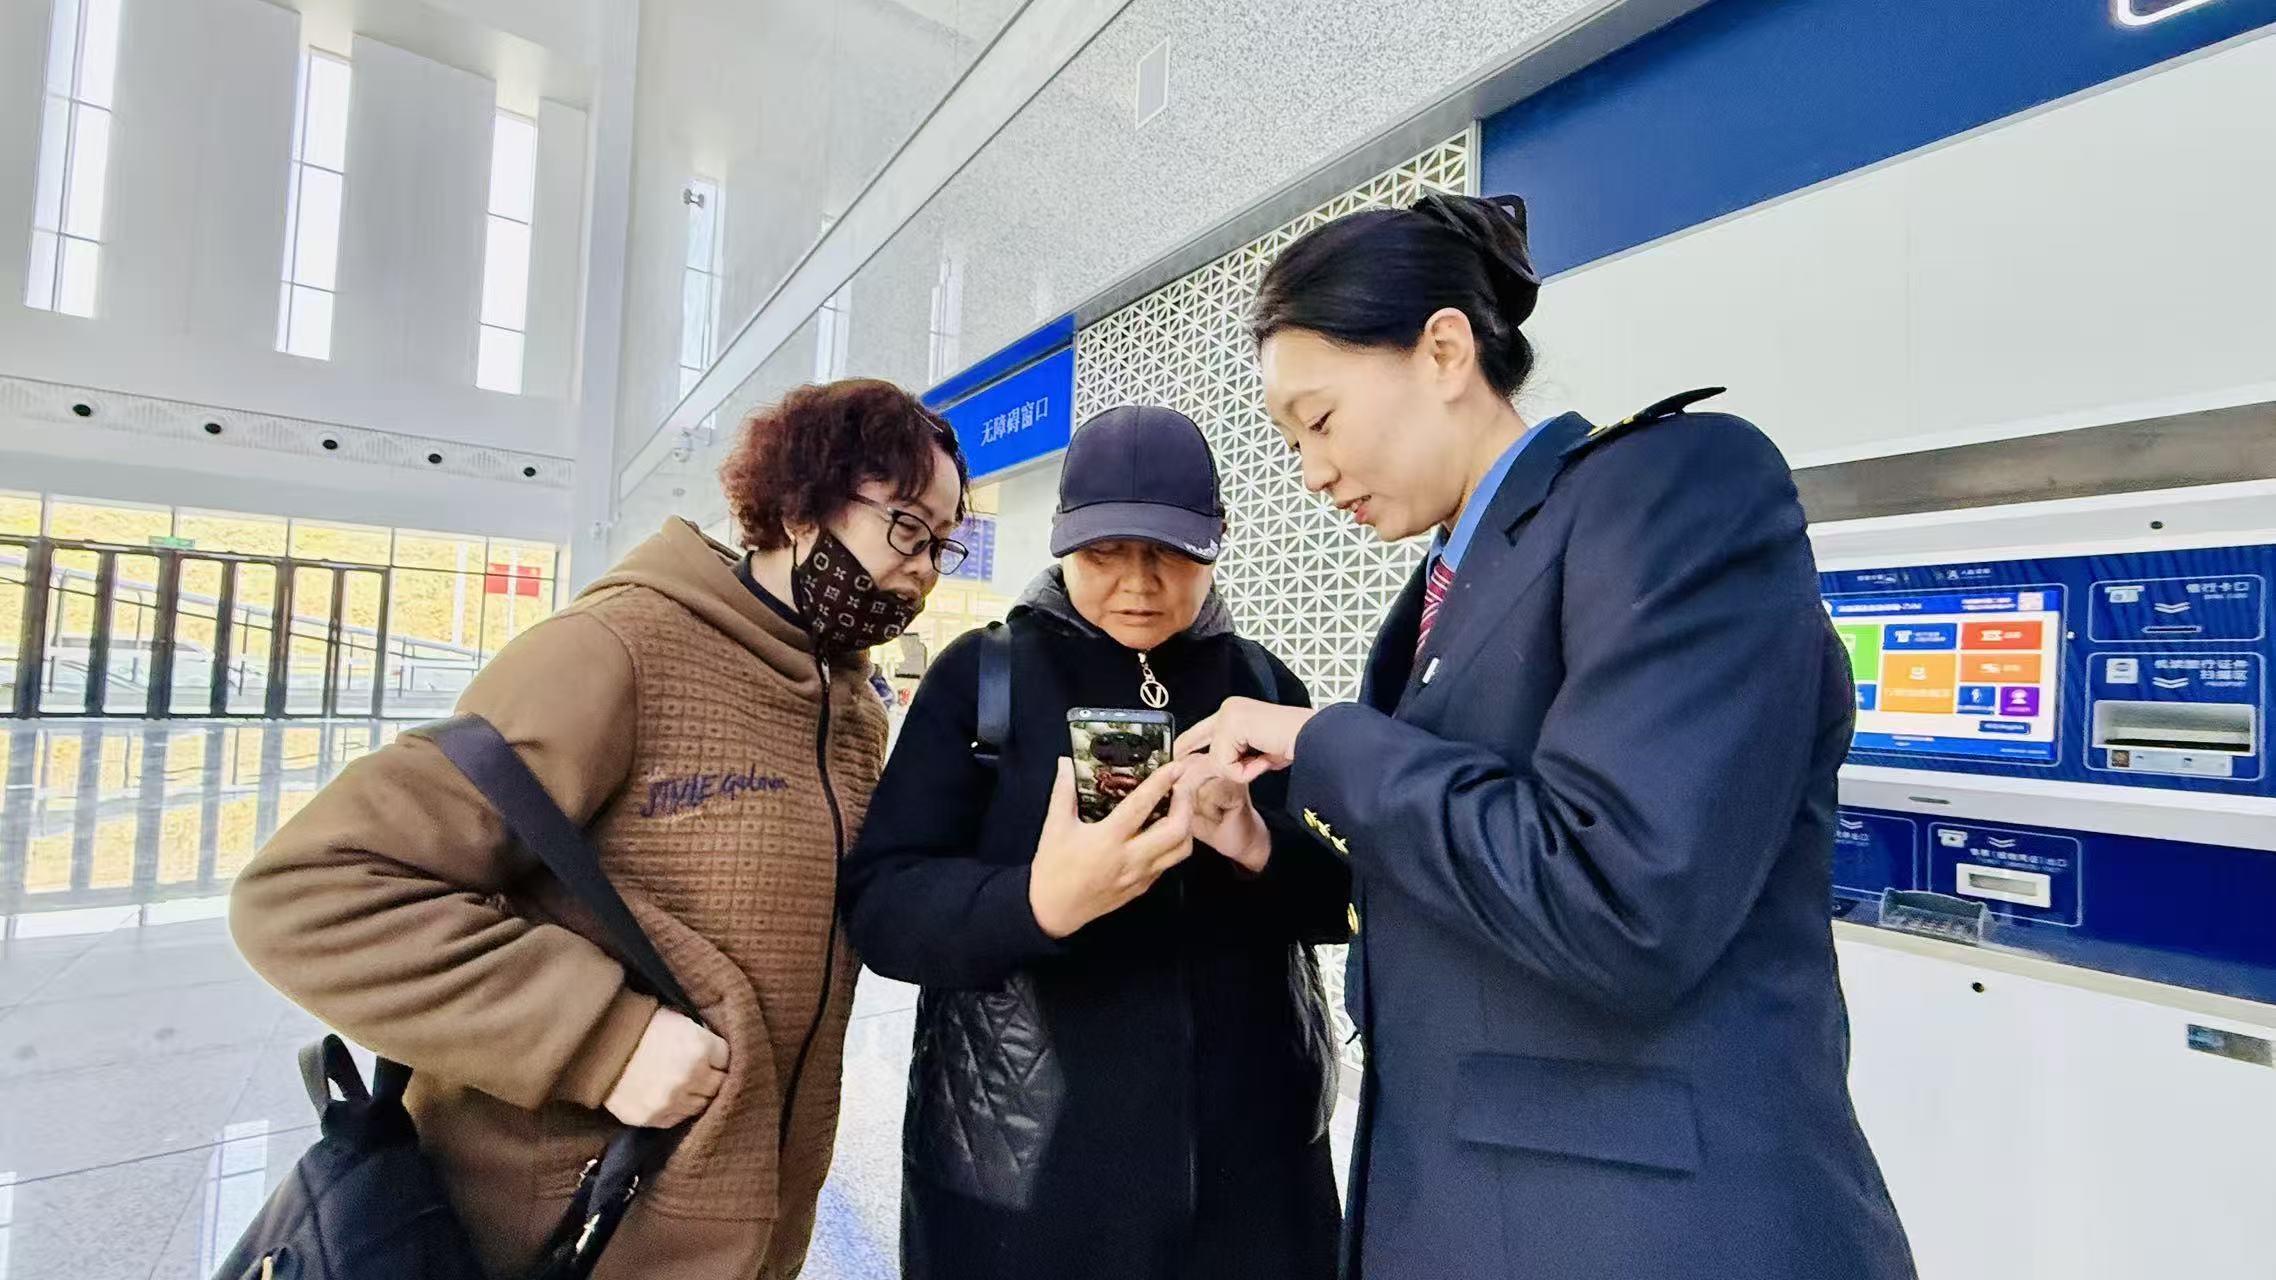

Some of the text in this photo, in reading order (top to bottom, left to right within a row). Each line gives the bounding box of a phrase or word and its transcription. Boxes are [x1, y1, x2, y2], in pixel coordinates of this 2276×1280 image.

[980, 396, 1049, 447] 无障碍窗口
